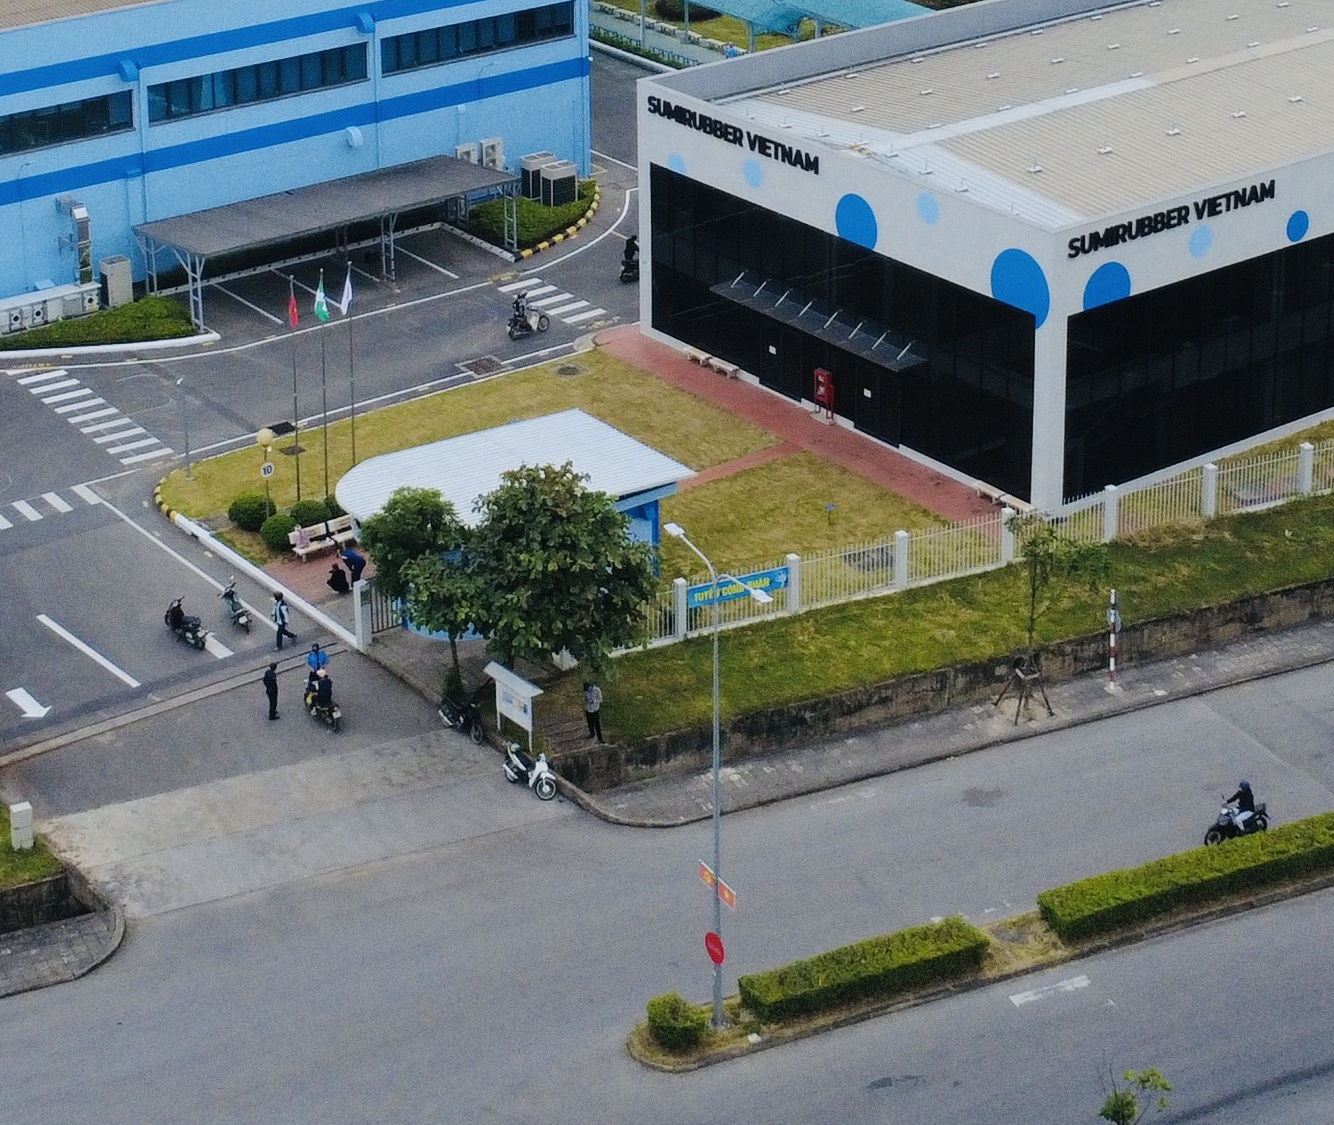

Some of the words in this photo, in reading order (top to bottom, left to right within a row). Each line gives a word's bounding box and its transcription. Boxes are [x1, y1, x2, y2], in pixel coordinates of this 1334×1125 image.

[648, 96, 743, 147] SUMIRUBBER
[747, 131, 818, 174] VIETNAM
[1068, 206, 1189, 258] SUMIRUBBER
[1193, 180, 1275, 220] VIETNAM
[262, 464, 273, 475] 10
